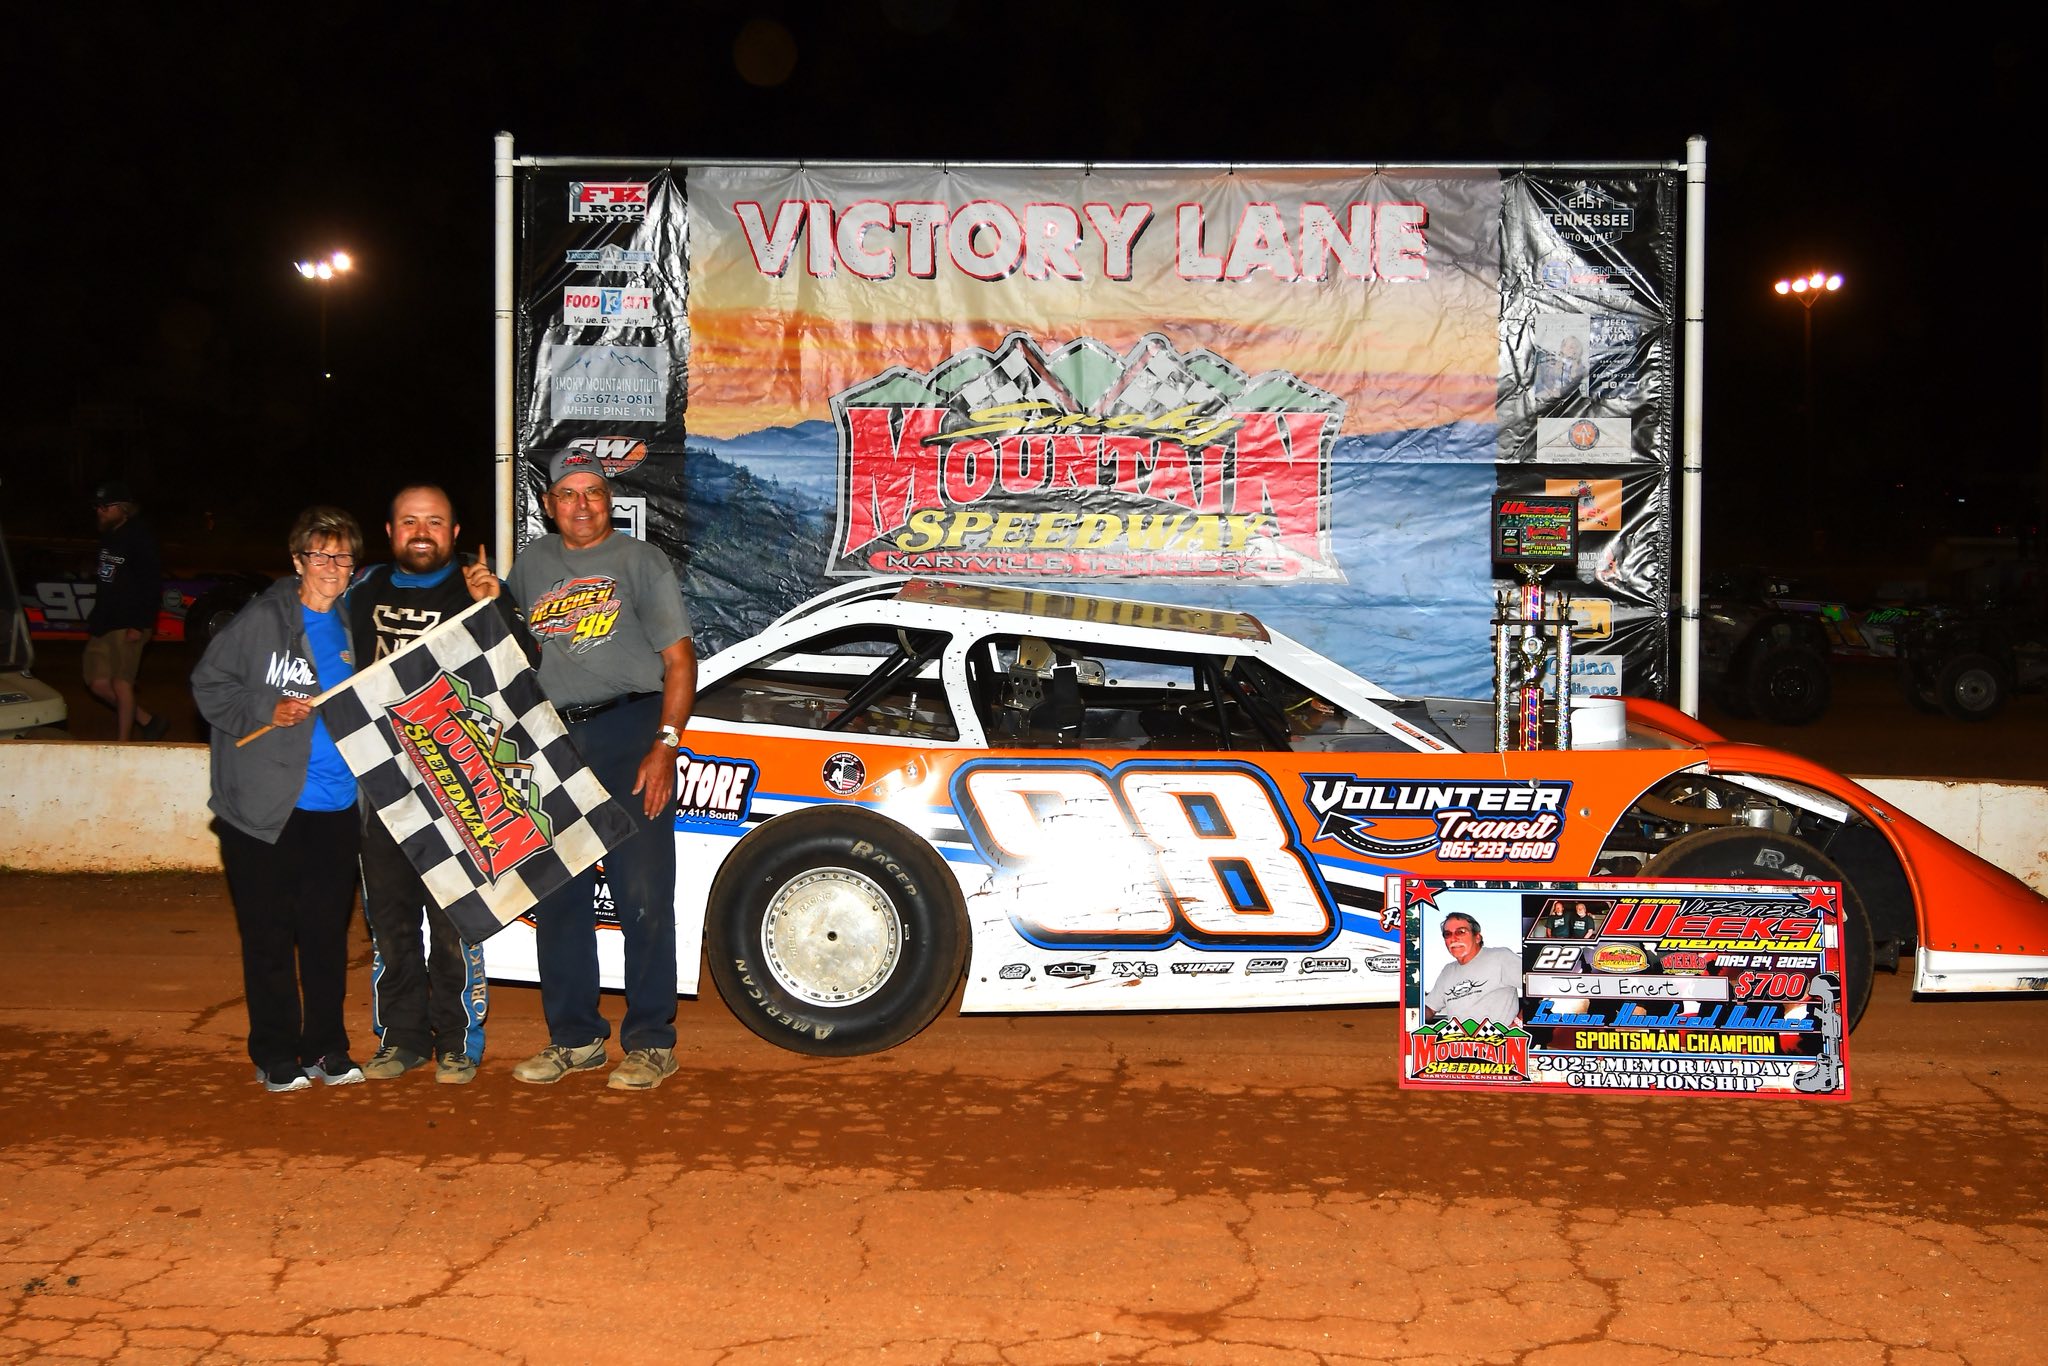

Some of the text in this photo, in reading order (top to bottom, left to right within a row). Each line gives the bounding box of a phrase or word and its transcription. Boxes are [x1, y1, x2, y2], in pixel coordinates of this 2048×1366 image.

[580, 186, 646, 202] FK
[1568, 194, 1604, 209] EAST
[589, 204, 645, 213] ROD
[571, 215, 645, 223] ENDS
[1545, 213, 1629, 226] TENNESSEE
[734, 200, 1429, 281] VICTORY LANE
[1560, 231, 1580, 242] AUTO
[566, 295, 600, 308] FOOD
[555, 377, 664, 393] SMOKY MOUNTAIN UTILITY
[573, 394, 652, 405] 65-674-0811
[564, 406, 600, 416] WHITE
[603, 407, 630, 416] PINE
[641, 408, 655, 417] TN
[922, 402, 1245, 446] Smoky
[842, 408, 1338, 561] MOUNTAIN
[896, 510, 1270, 552] SPEEDWAY
[887, 555, 1073, 571] MARYVILLE,
[1543, 682, 1618, 697] Apliance
[390, 675, 549, 879] MOUNTAIN
[676, 754, 750, 811] STORE
[404, 724, 500, 851] SPEEDWAY
[1311, 780, 1563, 814] VOLUNTEER
[688, 808, 706, 818] 411
[708, 810, 738, 821] South
[1437, 811, 1558, 840] Transit
[966, 770, 1331, 935] 98
[1439, 841, 1556, 859] 865-233-6609
[851, 840, 919, 897] RACER
[1681, 898, 1811, 919] LESTER
[1600, 903, 1820, 940] WEEKS
[1657, 933, 1824, 951] memorial
[1186, 963, 1233, 972] WRP
[1535, 946, 1582, 970] 22
[1662, 952, 1707, 970] WEEKS
[1715, 955, 1818, 970] MAY 24, 2025
[1050, 965, 1091, 975] ADC
[1551, 976, 1679, 996] Jed Emert
[1735, 971, 1806, 998] $700
[735, 959, 836, 1041] AMERICAN
[1527, 1001, 1815, 1031] Seven Hundred Dollars
[1433, 1032, 1507, 1047] Smoky
[1575, 1031, 1776, 1054] SPORTSMAN CHAMPION
[1412, 1034, 1530, 1078] MOUNTAIN
[1425, 1062, 1515, 1075] SPEEDWAY
[1537, 1056, 1793, 1077] 2025 MEMORIAL DAY
[1566, 1071, 1764, 1092] CHAMPIONSHIP
